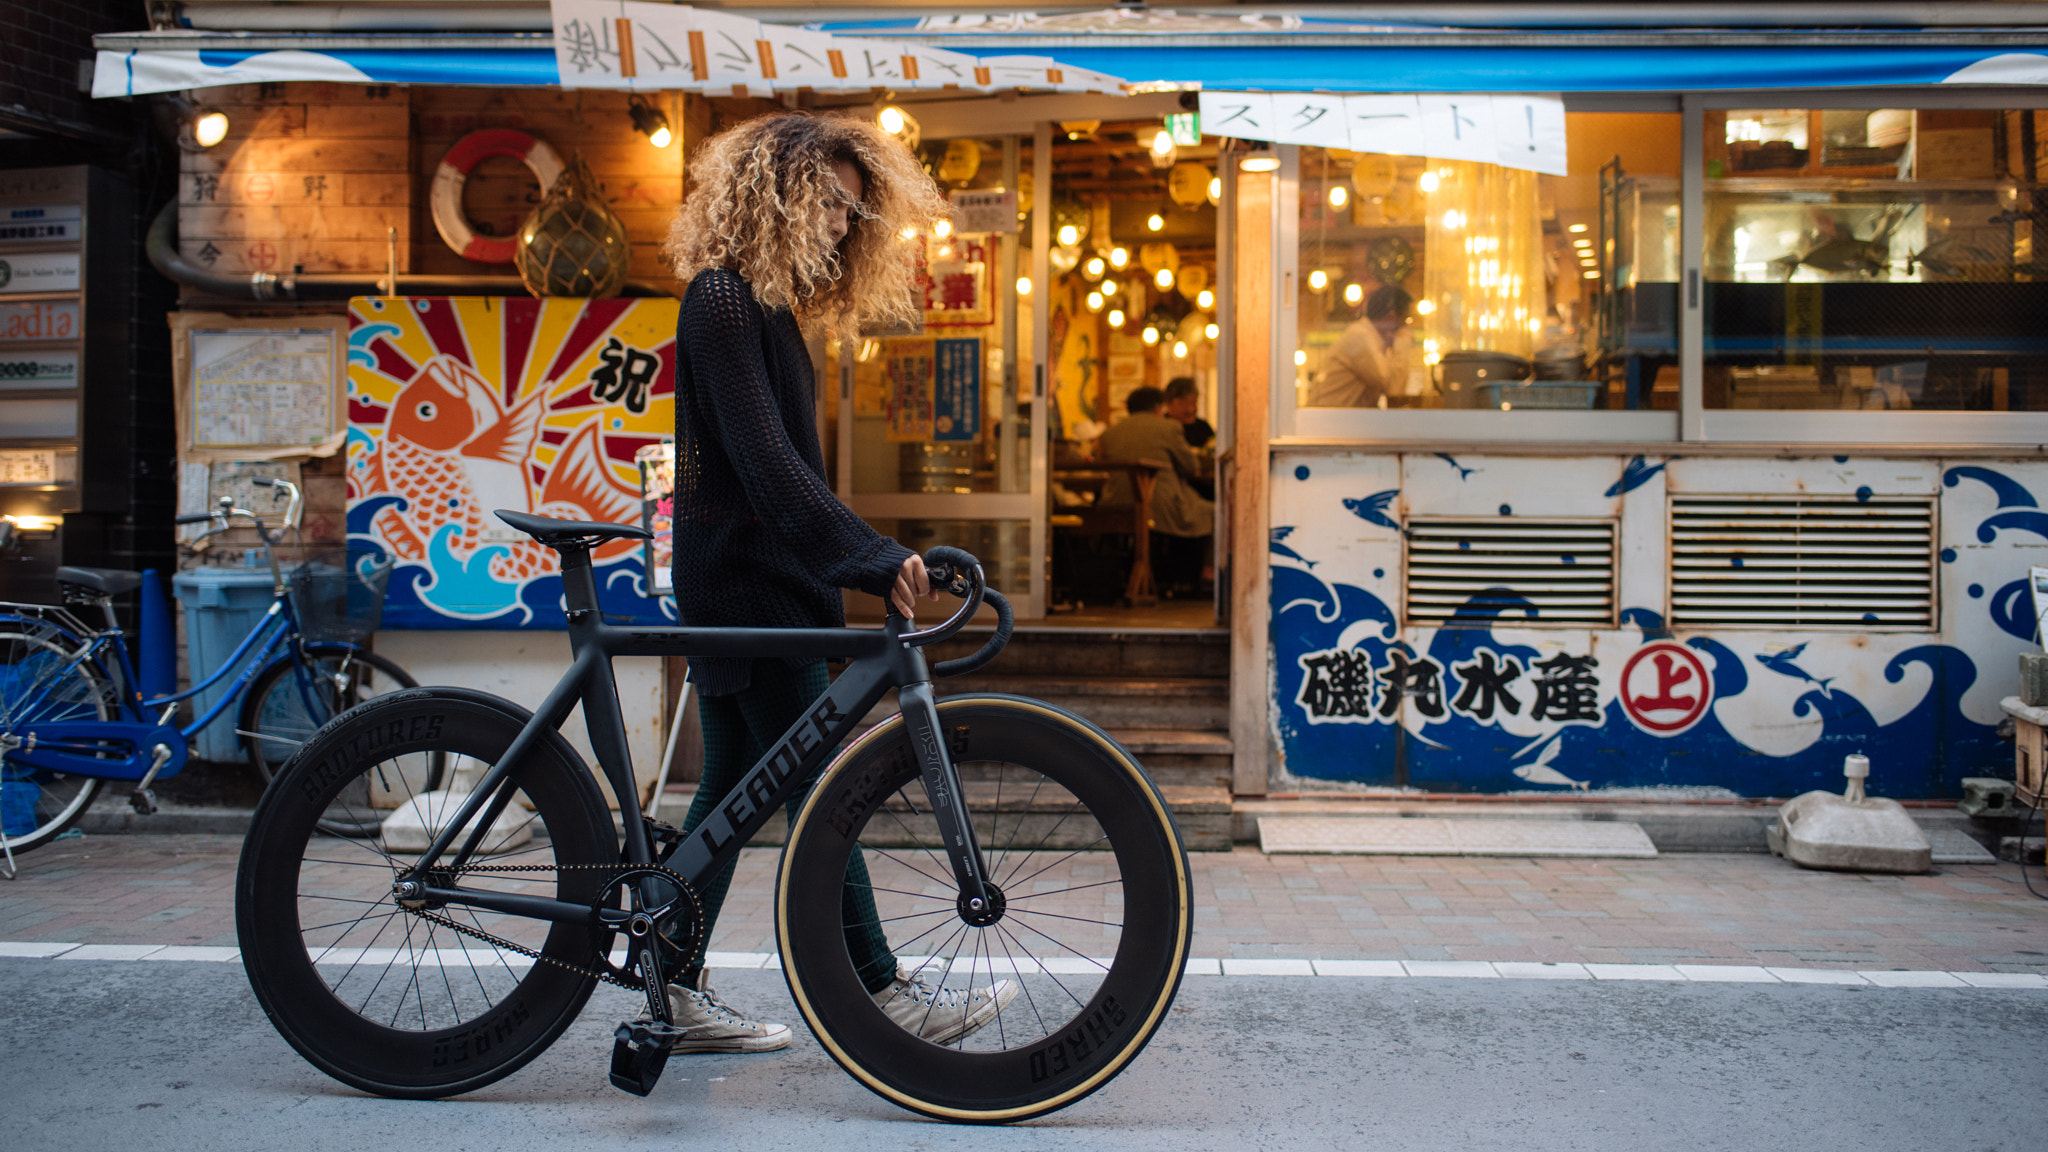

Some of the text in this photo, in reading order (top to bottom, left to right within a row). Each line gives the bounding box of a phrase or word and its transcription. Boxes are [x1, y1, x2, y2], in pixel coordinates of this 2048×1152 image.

[0, 305, 71, 338] adia
[591, 337, 659, 415] 祝
[1300, 648, 1602, 723] 磯丸水産
[300, 714, 446, 802] BROTURES
[701, 696, 849, 859] LEADER
[826, 724, 971, 840] BROTUS
[1029, 993, 1127, 1084] SHRED
